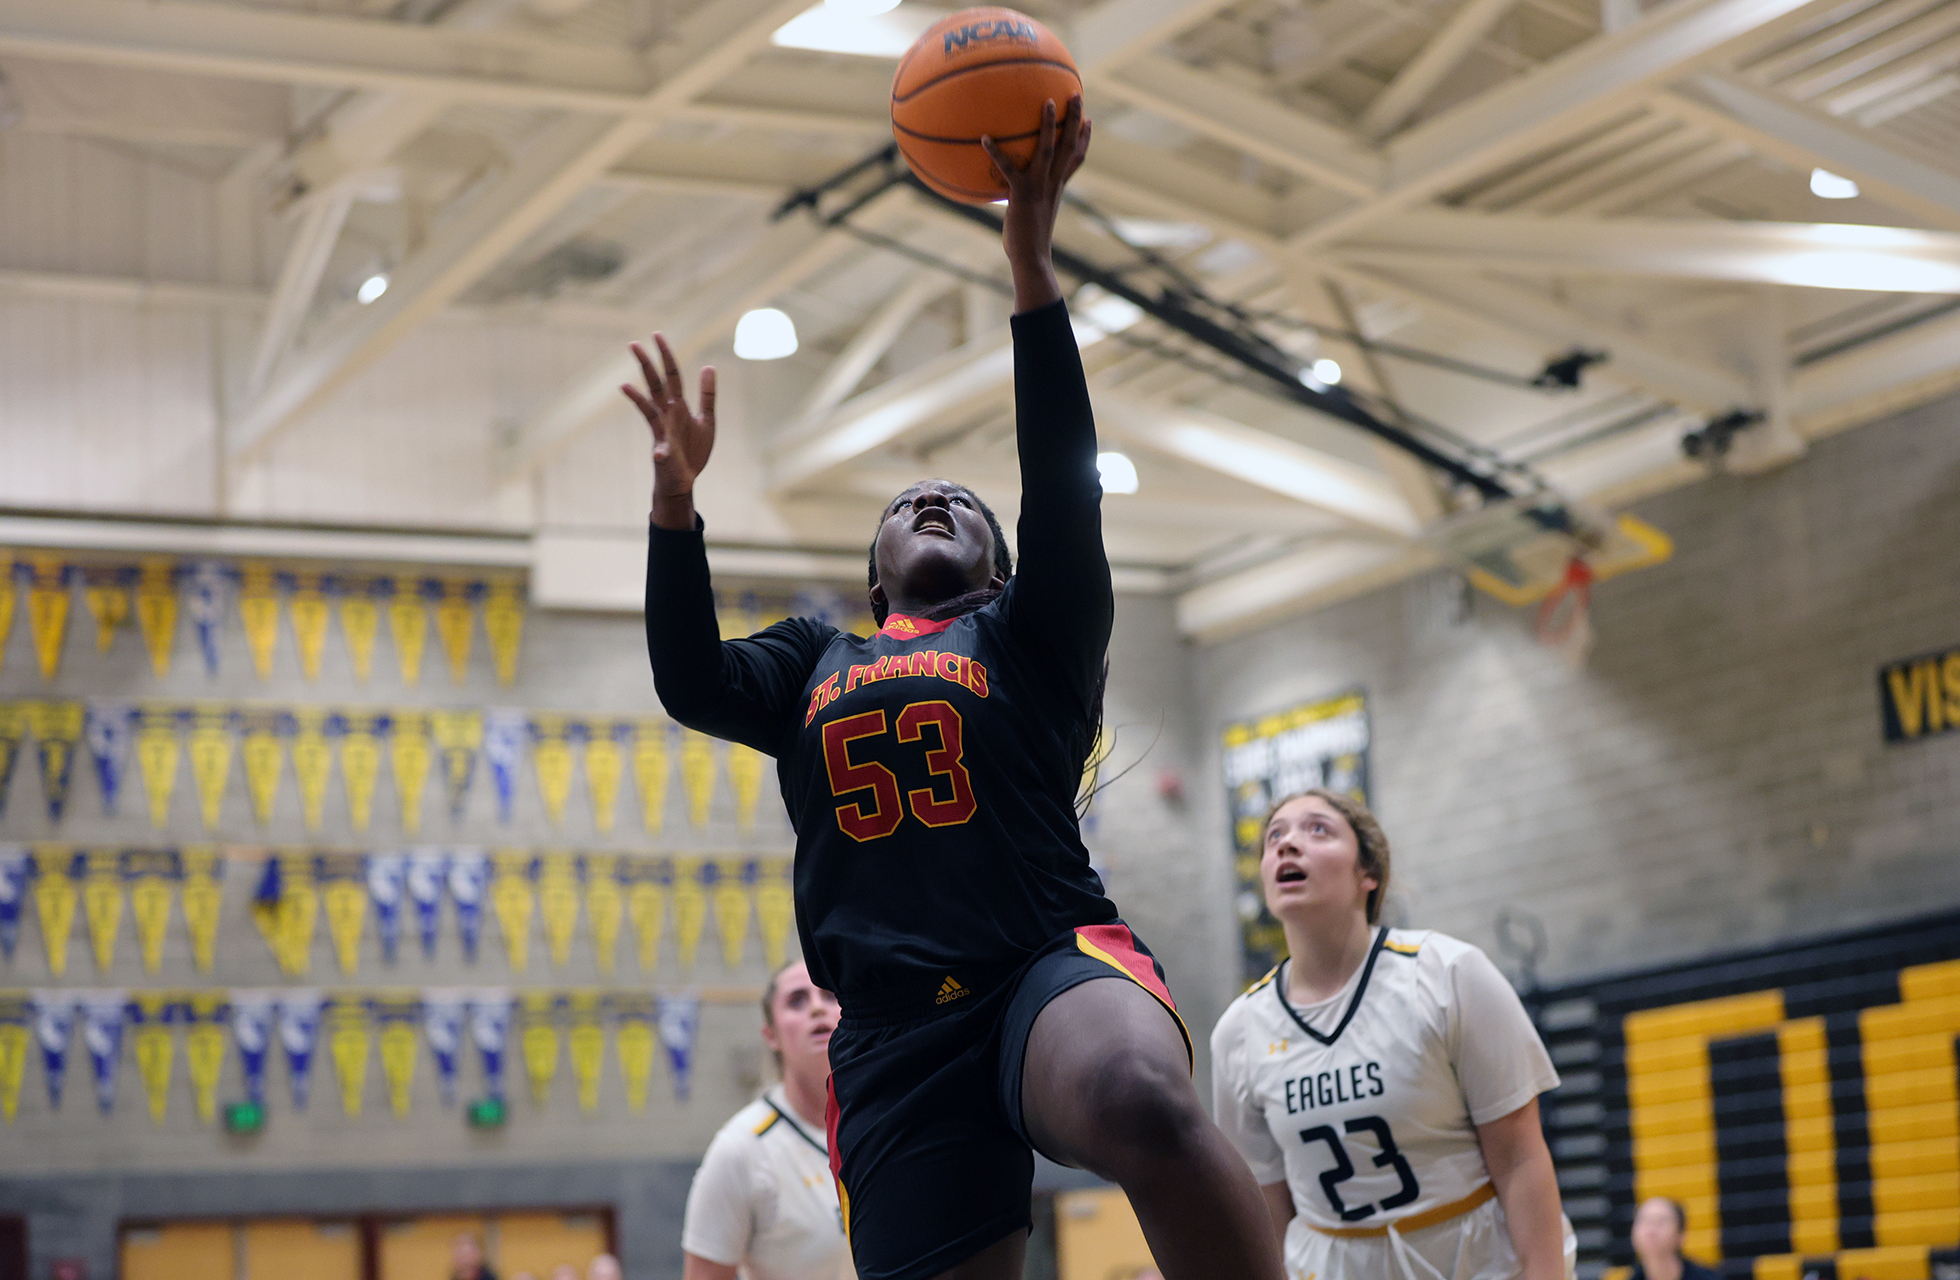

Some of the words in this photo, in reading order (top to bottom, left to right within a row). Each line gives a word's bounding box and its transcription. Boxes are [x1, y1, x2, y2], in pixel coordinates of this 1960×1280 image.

[944, 20, 1038, 55] NCAA
[885, 624, 920, 635] adidas
[805, 671, 841, 728] ST.
[844, 651, 989, 698] FRANCIS
[822, 700, 977, 842] 53
[935, 987, 970, 1005] adidas
[1285, 1062, 1384, 1115] EAGLES
[1299, 1115, 1420, 1222] 23
